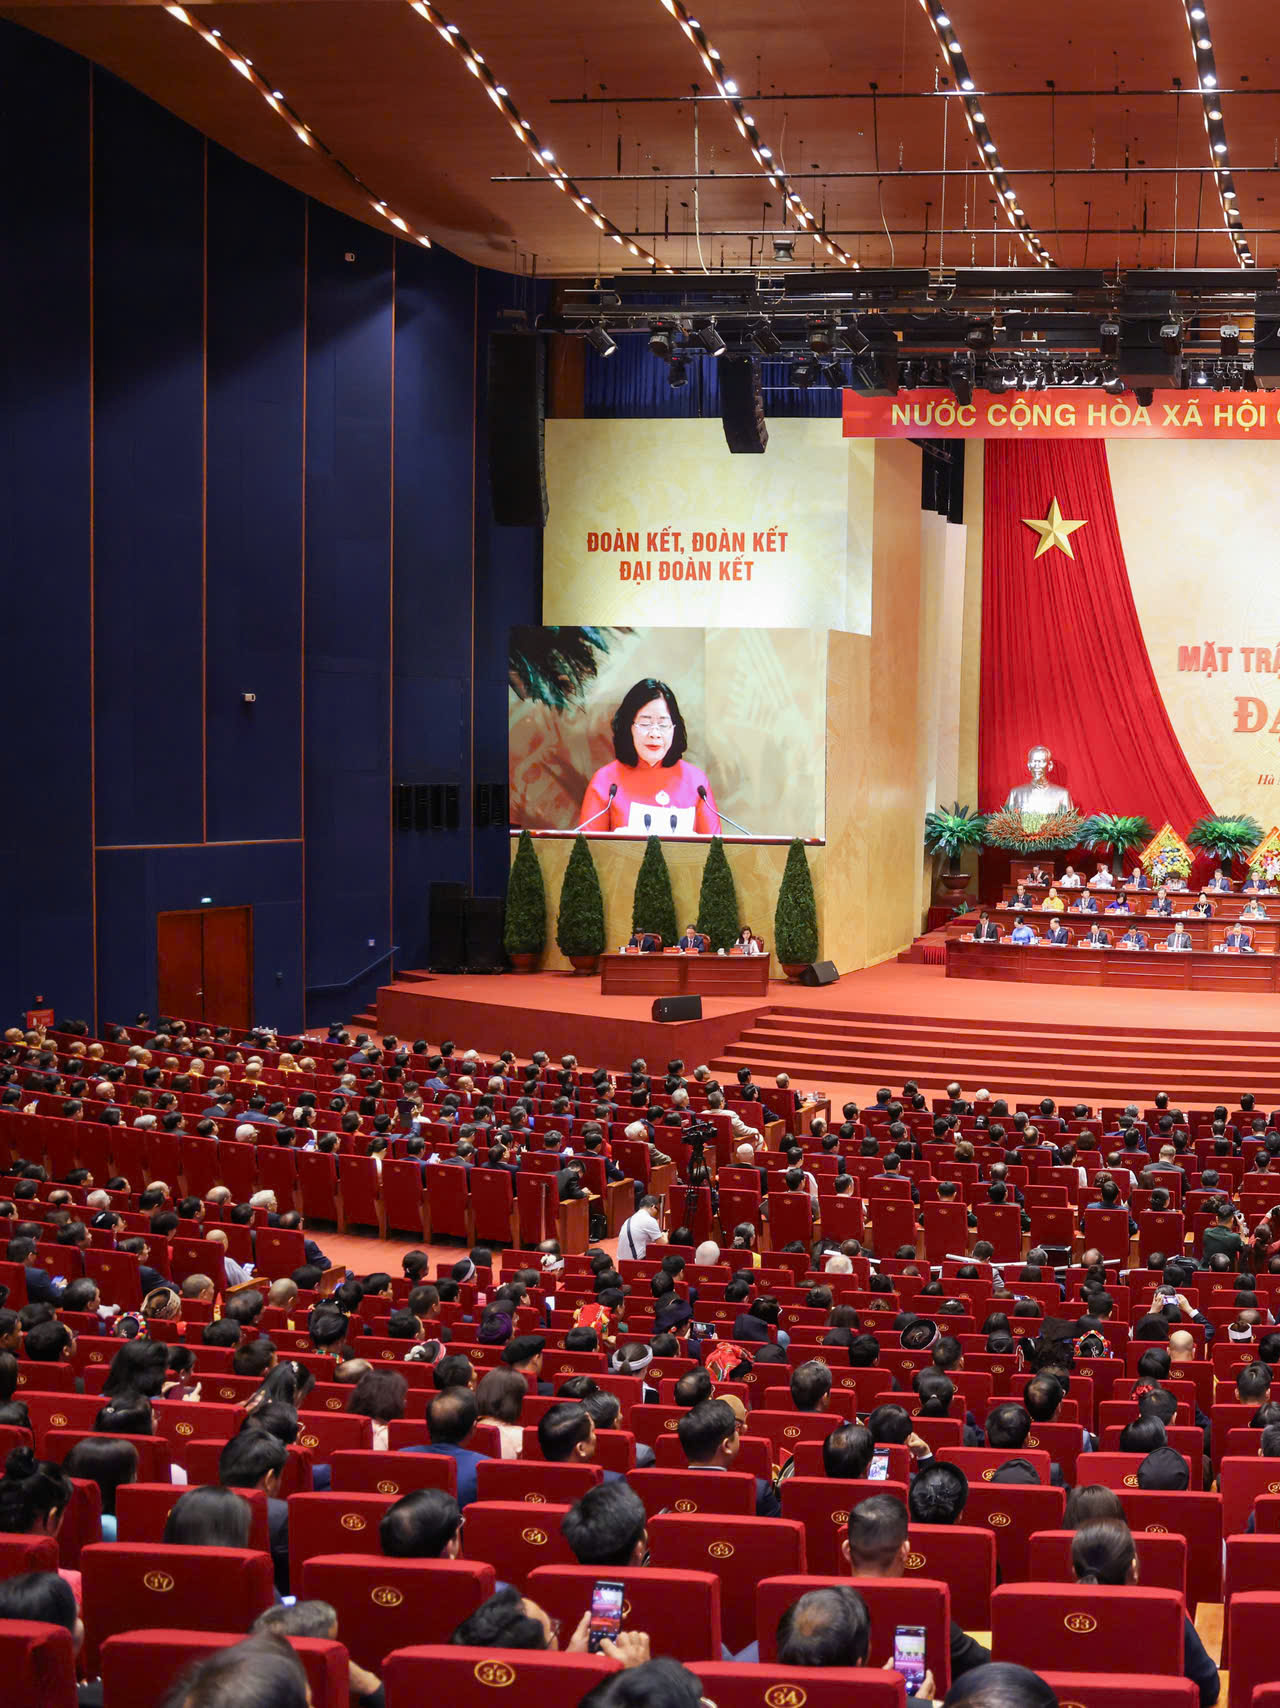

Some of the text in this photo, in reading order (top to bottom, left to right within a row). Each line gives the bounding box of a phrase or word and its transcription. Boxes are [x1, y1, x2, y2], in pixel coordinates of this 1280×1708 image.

[891, 398, 976, 427] NƯỚC
[987, 399, 1076, 430] CỘNG
[1088, 398, 1152, 427] HÒA
[1161, 399, 1204, 427] XÃ
[1214, 398, 1266, 432] HỘI
[587, 525, 788, 554] ĐOÀN KẾT, ĐOÀN KẾT
[619, 555, 754, 585] ĐẠI ĐOÀN KẾT
[1178, 641, 1233, 678] MẶT
[1257, 774, 1275, 786] Hà
[482, 1666, 508, 1683] 35
[773, 1690, 798, 1705] 34
